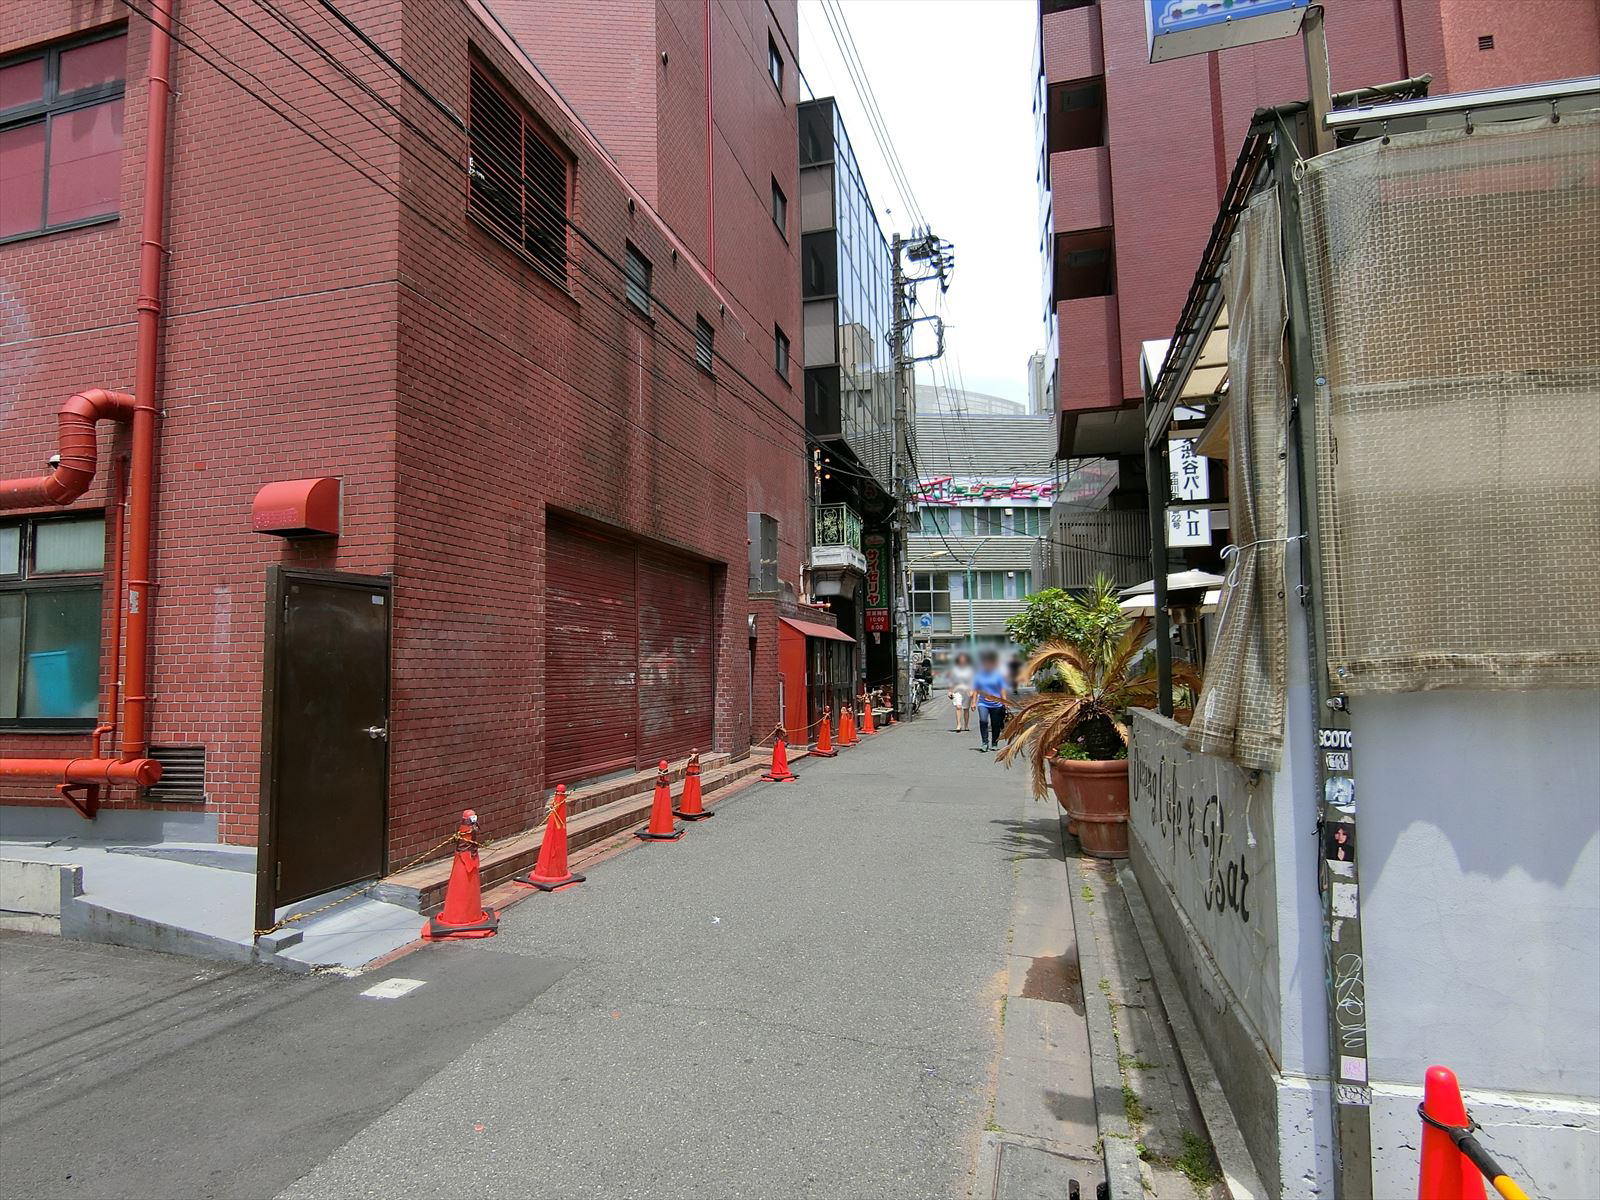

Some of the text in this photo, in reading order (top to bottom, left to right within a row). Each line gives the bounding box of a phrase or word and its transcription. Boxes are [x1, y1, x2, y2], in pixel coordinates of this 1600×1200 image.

[1181, 438, 1200, 536] 渋谷パートII
[1203, 795, 1249, 923] Bar
